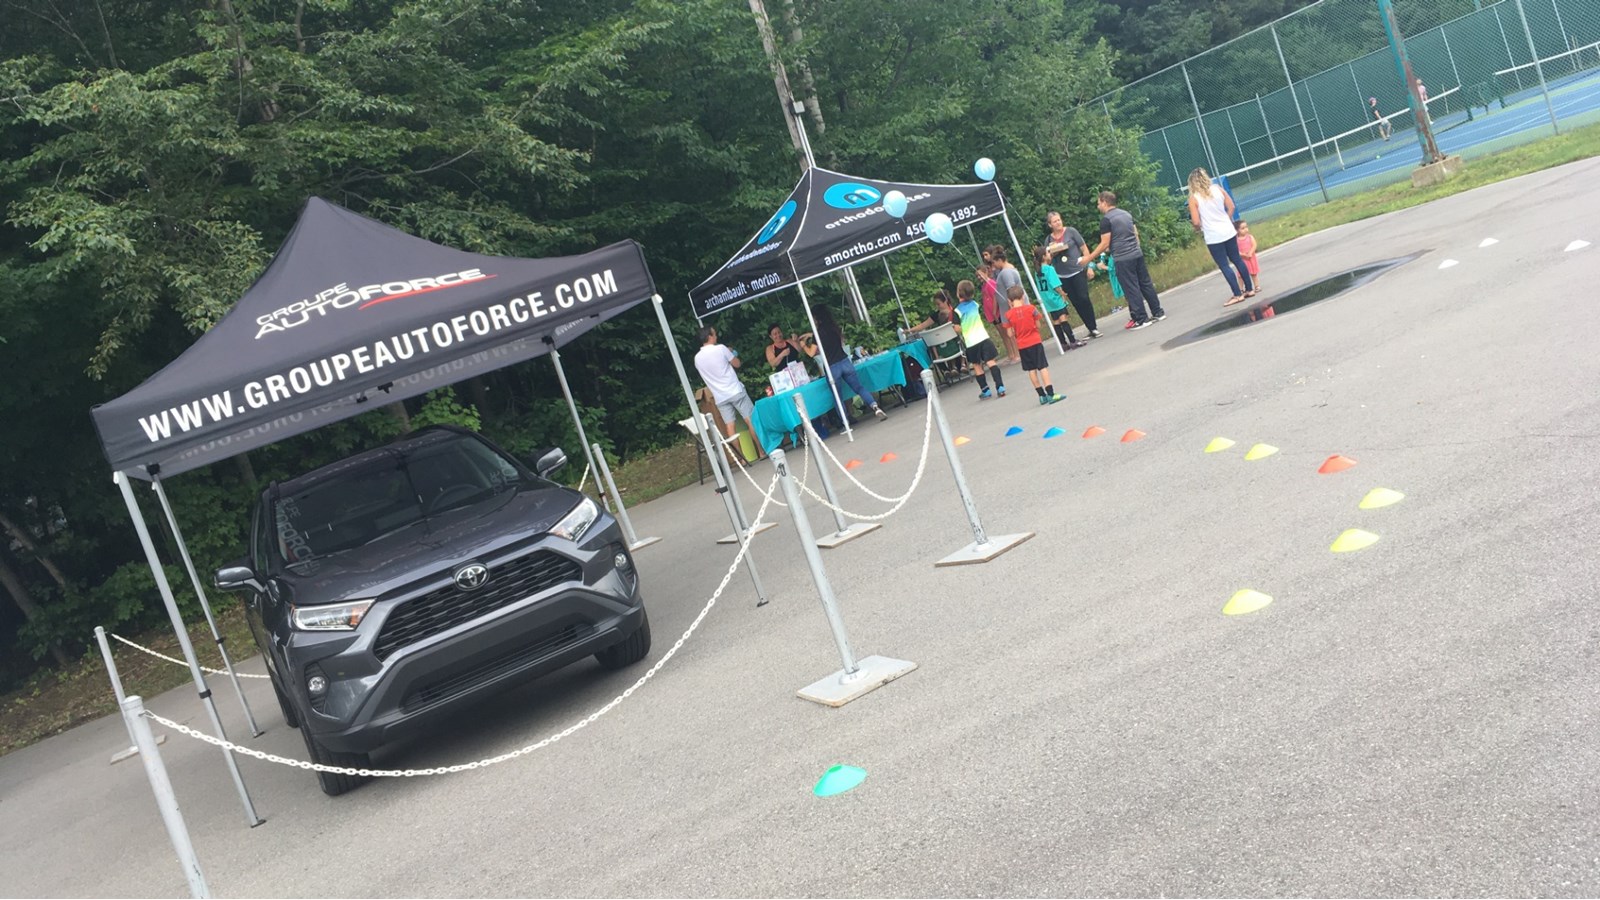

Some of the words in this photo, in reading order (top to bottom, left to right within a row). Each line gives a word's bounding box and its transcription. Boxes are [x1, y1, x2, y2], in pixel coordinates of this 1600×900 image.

[825, 192, 932, 230] orthodotes
[824, 231, 902, 266] amortho.com
[906, 221, 926, 237] 450
[255, 268, 487, 339] AUTOFORCE
[256, 282, 350, 326] GROUPE
[704, 281, 748, 309] archambault
[750, 272, 781, 291] morton
[138, 269, 618, 443] WWW.GROUPEAUTOFORCE.COM
